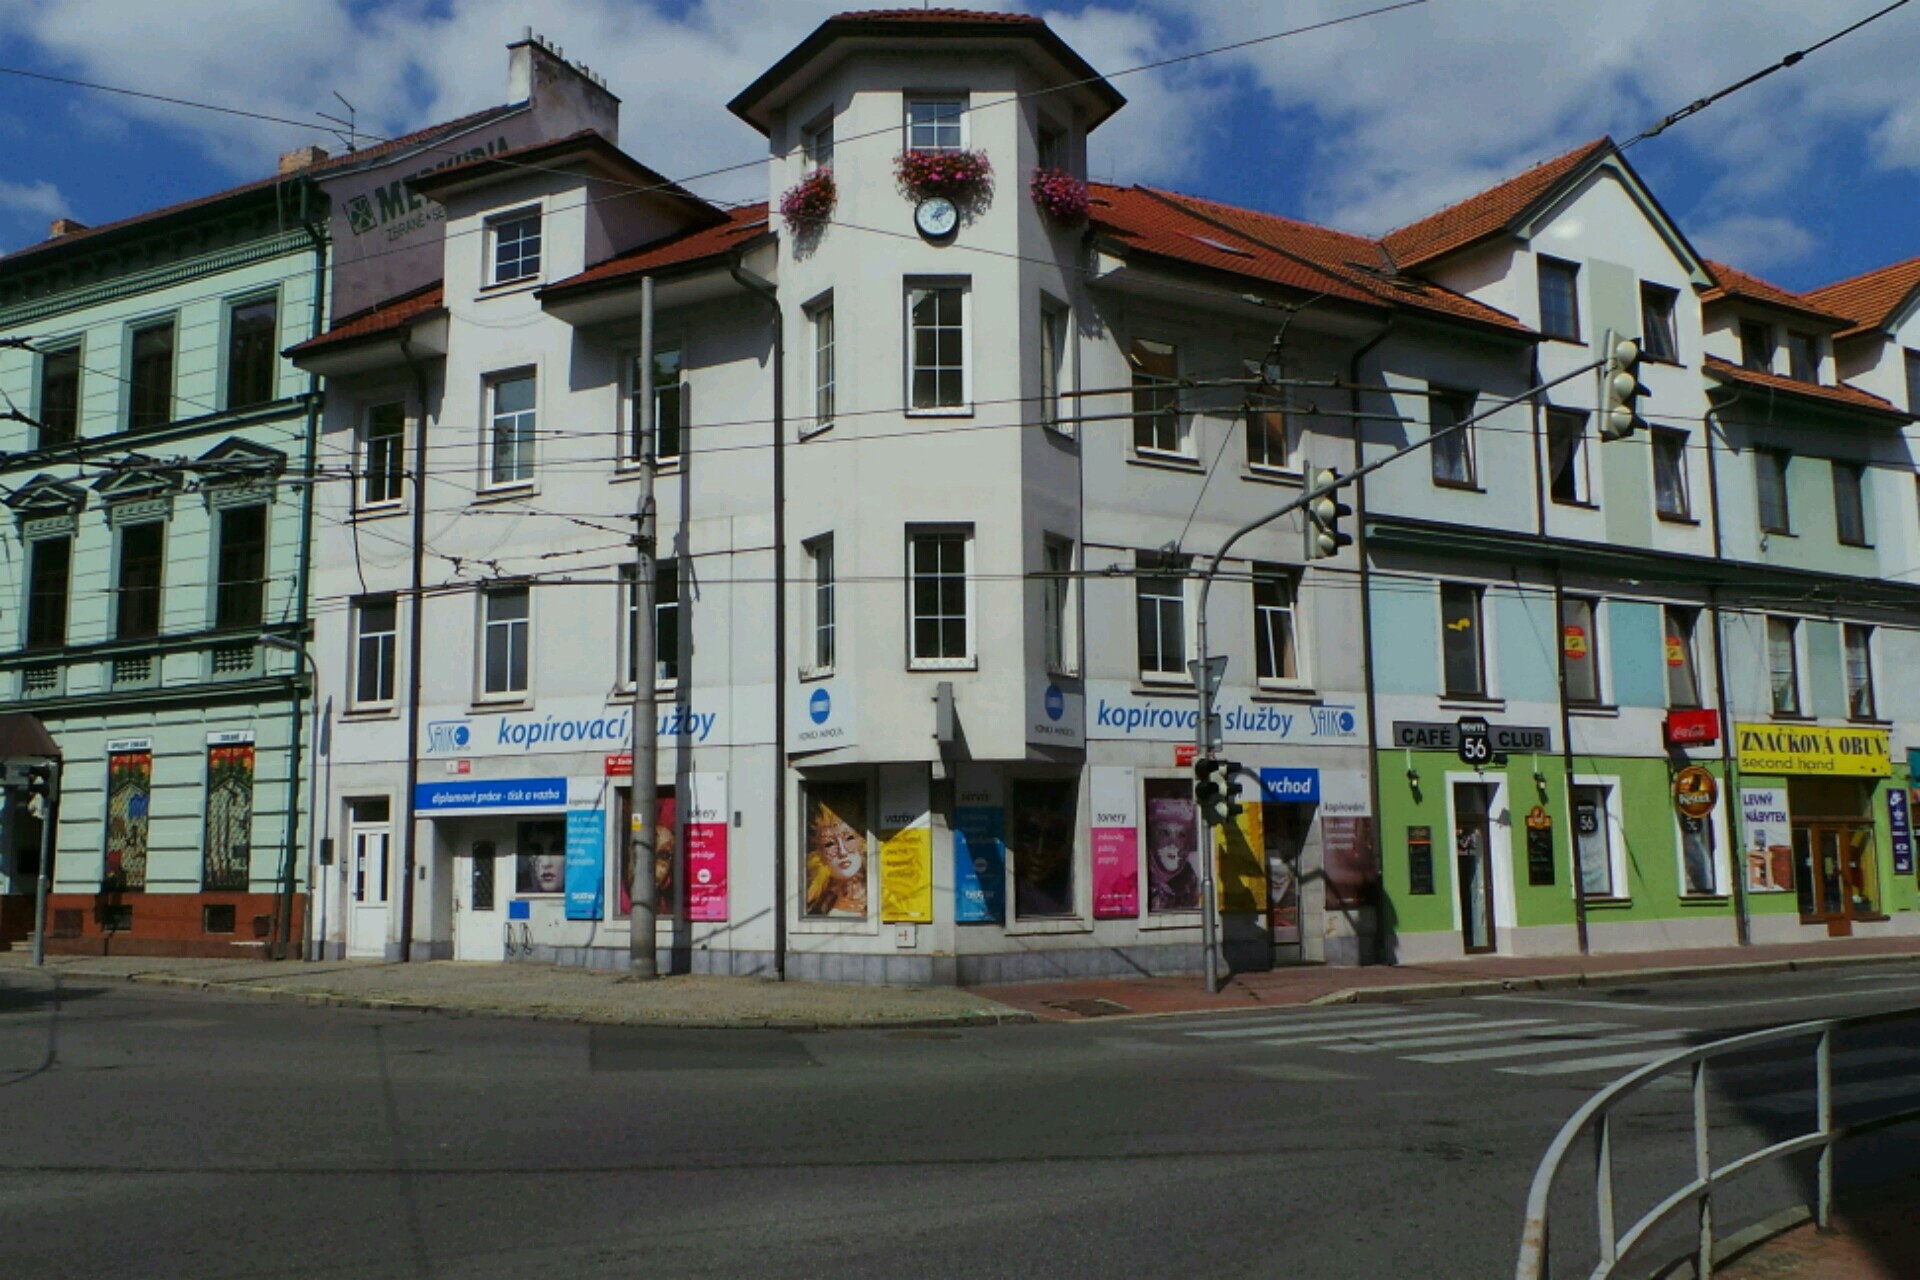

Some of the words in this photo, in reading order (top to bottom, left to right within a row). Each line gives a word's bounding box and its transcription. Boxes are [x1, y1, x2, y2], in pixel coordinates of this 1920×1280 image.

[1097, 699, 1222, 733] kopírova
[1224, 706, 1293, 738] služby
[497, 710, 629, 750] kopírovací
[1401, 726, 1452, 745] CAFÉ
[1464, 737, 1487, 760] 56
[1498, 731, 1545, 748] CLUB
[1740, 728, 1834, 755] ZNAČKOVÁ
[1742, 757, 1793, 769] second
[1797, 757, 1835, 771] hand
[1266, 776, 1312, 794] vchod
[1743, 791, 1773, 806] LEVNÝ
[1097, 812, 1126, 824] tonery
